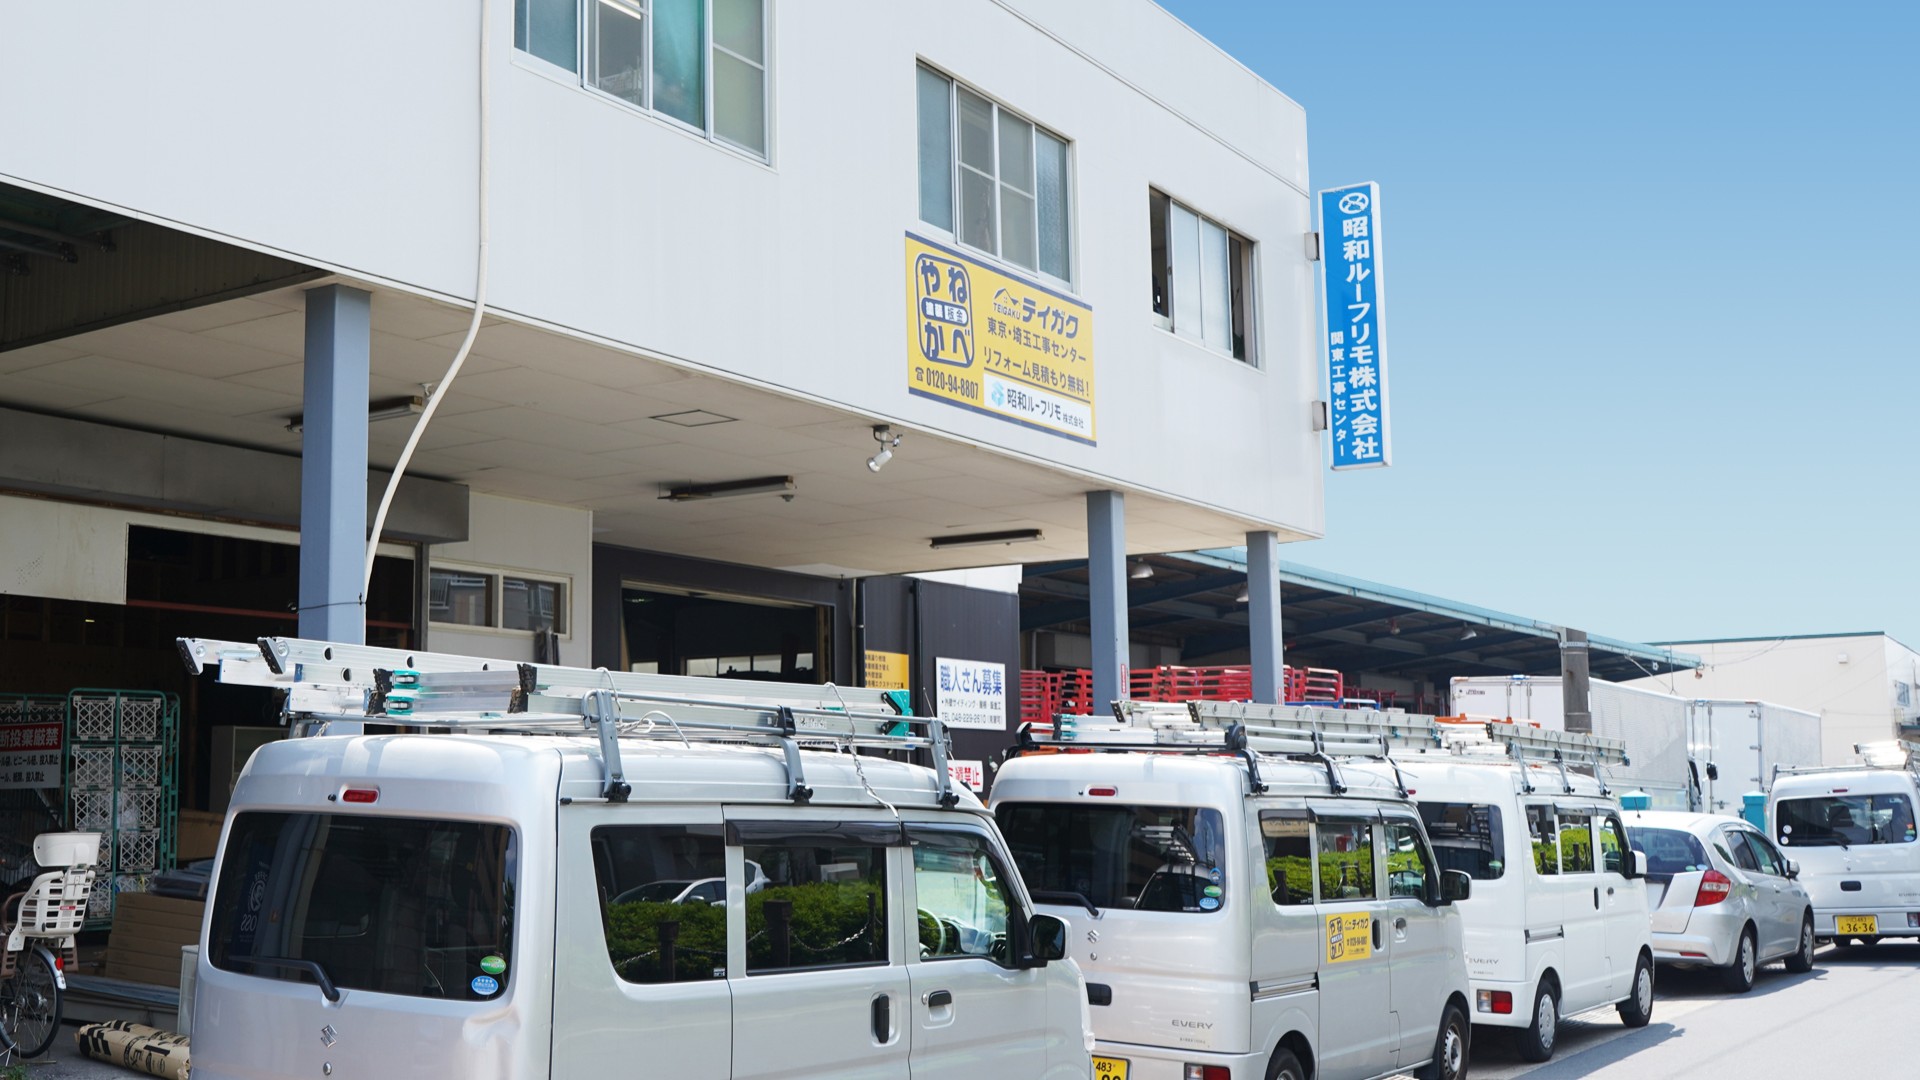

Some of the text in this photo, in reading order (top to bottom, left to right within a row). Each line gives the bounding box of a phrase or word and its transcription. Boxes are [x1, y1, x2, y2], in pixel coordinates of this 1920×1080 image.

[921, 259, 968, 304] やね
[993, 302, 1021, 320] TEIGAKU
[1022, 297, 1079, 339] テイガク
[924, 321, 971, 362] かべ
[987, 316, 1087, 363] 東京・埼玉工事センター
[1343, 216, 1380, 461] 昭和ルーフリモ株式会社
[926, 367, 979, 400] 0120-94-8807
[1330, 331, 1347, 457] 関東工事センター
[1007, 388, 1084, 429] 昭和ルーフリモ 株式会社
[940, 664, 1002, 696] 職人さん募集
[1846, 923, 1875, 933] 36-36
[1171, 1019, 1213, 1030] EVERY
[1095, 1061, 1112, 1073] 483
